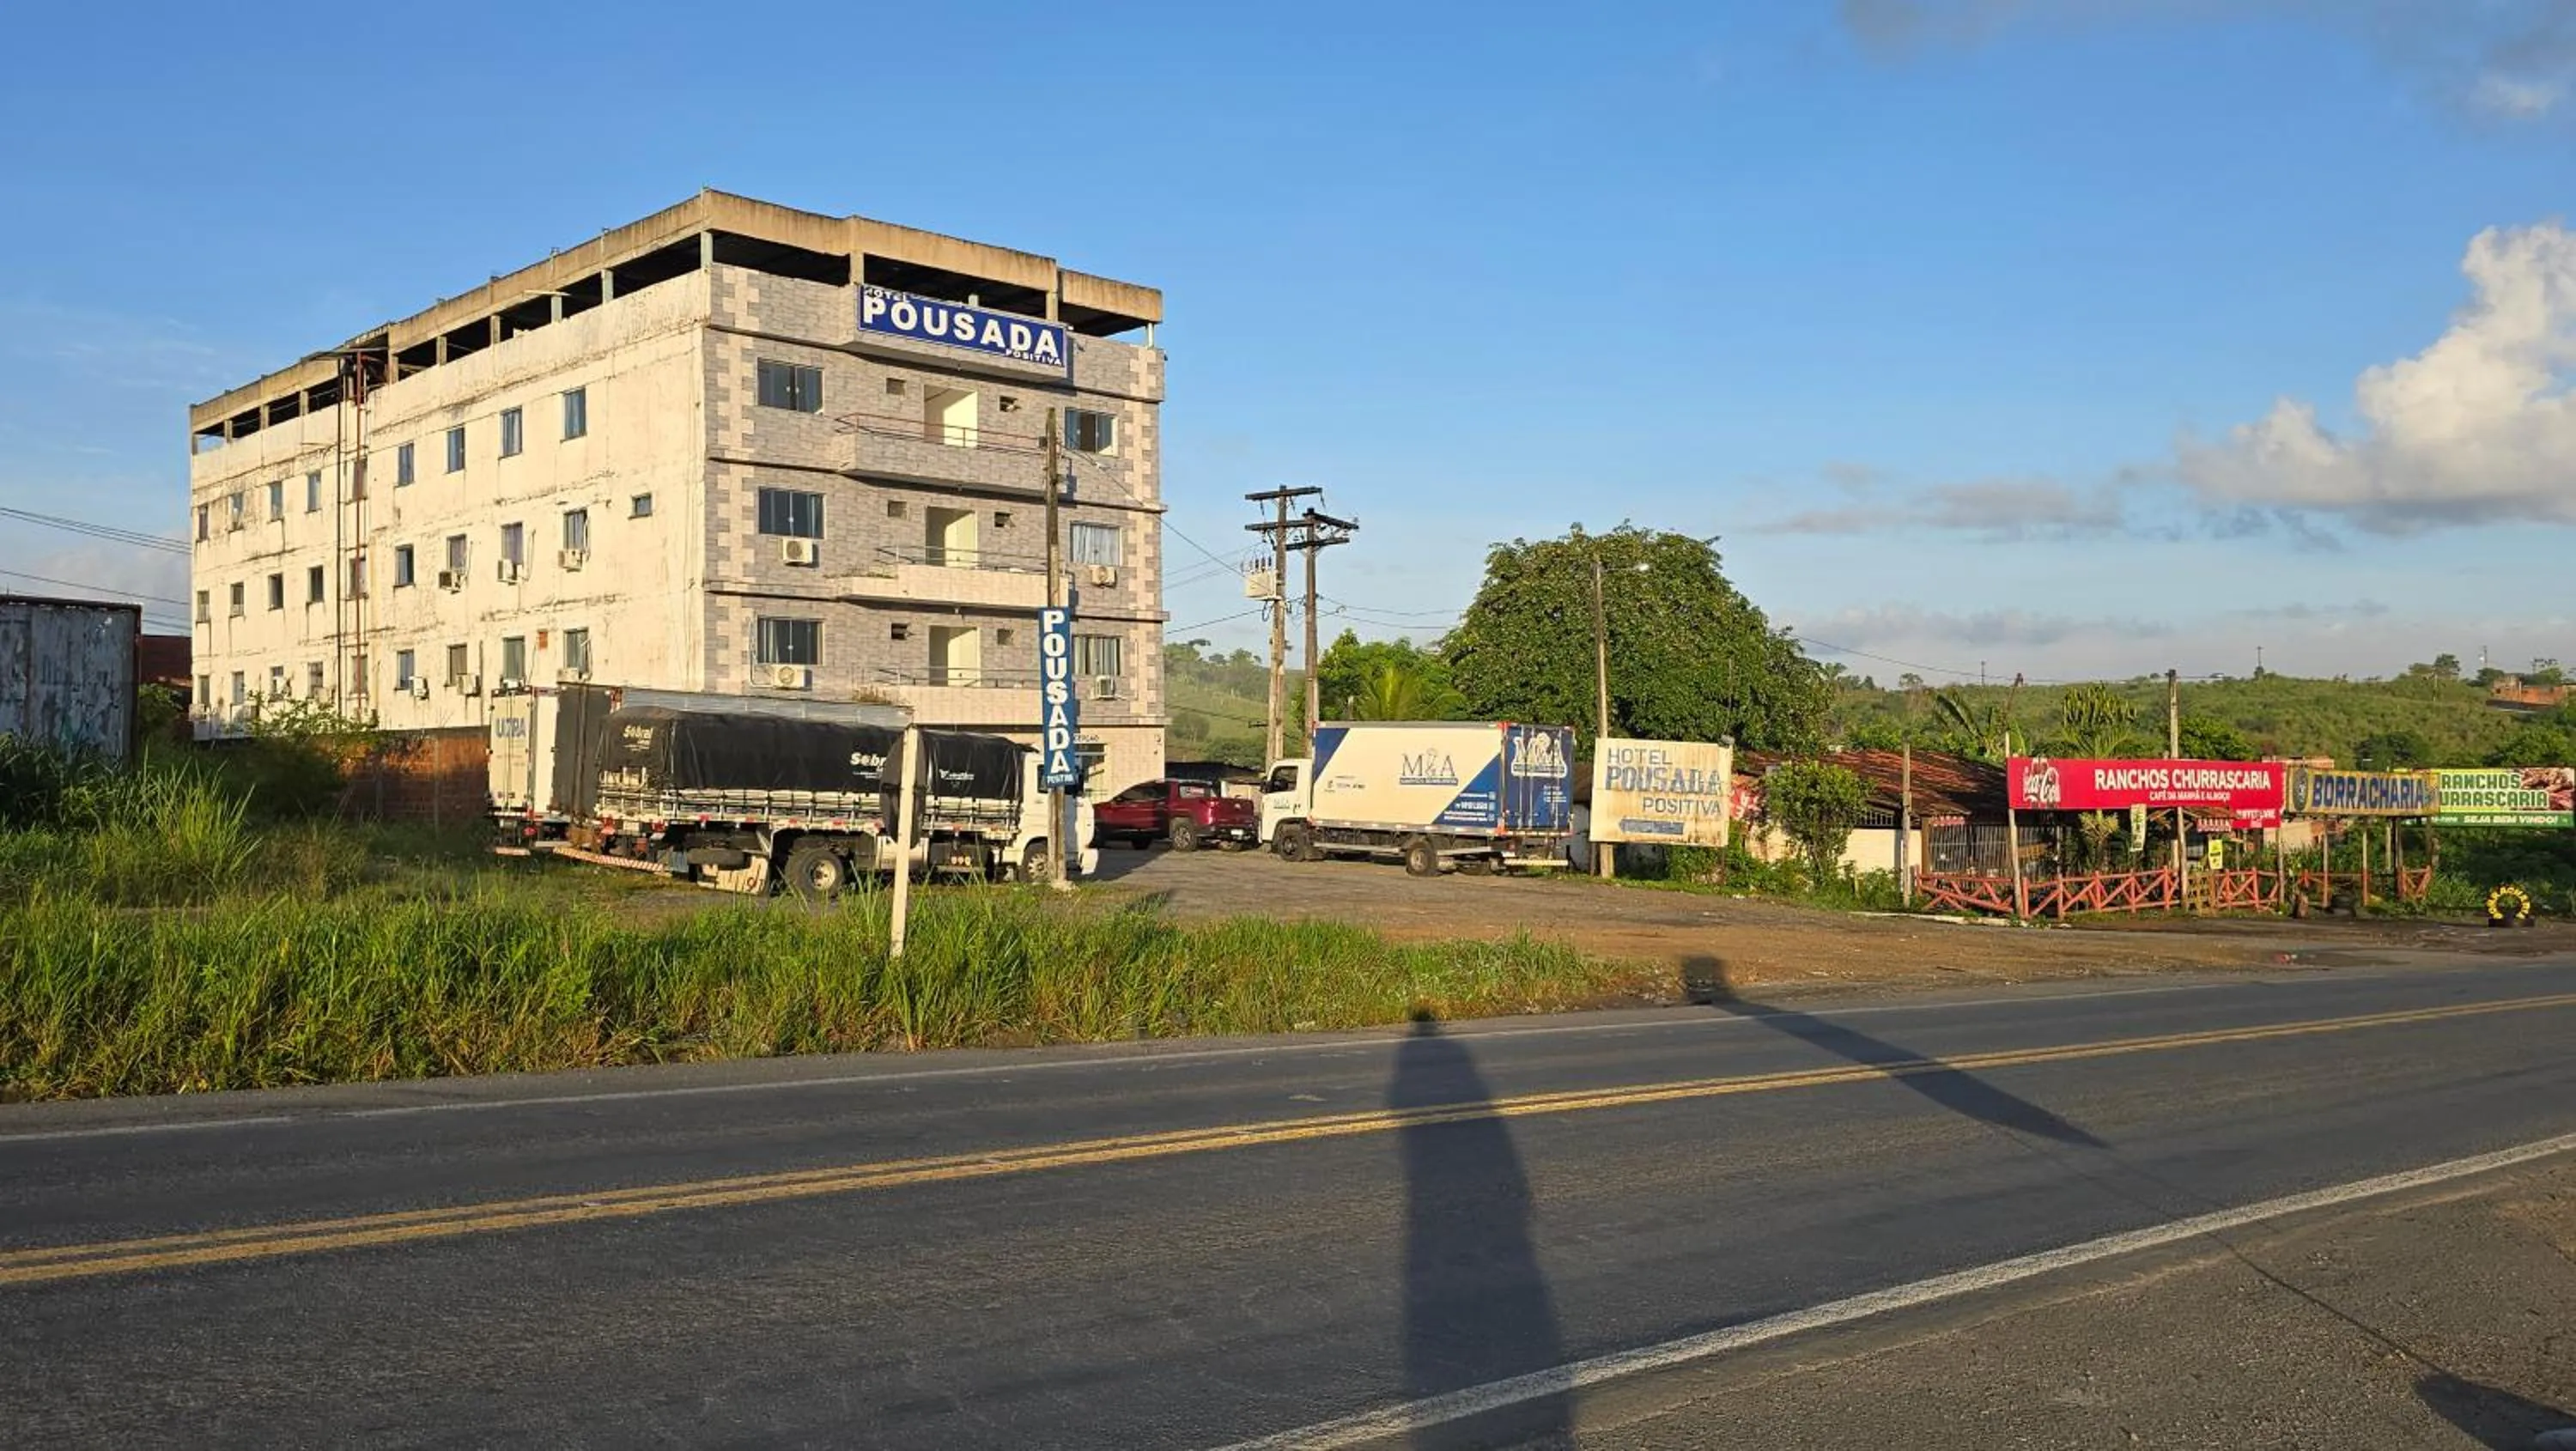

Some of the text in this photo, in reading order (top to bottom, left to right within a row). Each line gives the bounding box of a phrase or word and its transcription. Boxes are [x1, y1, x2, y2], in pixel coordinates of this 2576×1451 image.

[863, 296, 1059, 358] POUSADA
[1005, 349, 1062, 366] POSITIVA
[1042, 610, 1071, 773] POUSADA
[1607, 748, 1673, 765] HOTEL
[1605, 765, 1723, 796] POUSADA
[2094, 768, 2271, 790] RANCHOS CHURRASCARIA
[2442, 774, 2521, 790] RANCHOS
[2312, 774, 2426, 810] BORRACHARIA
[2440, 790, 2549, 808] URRASCARIA
[1643, 796, 1722, 815] POSITIVA
